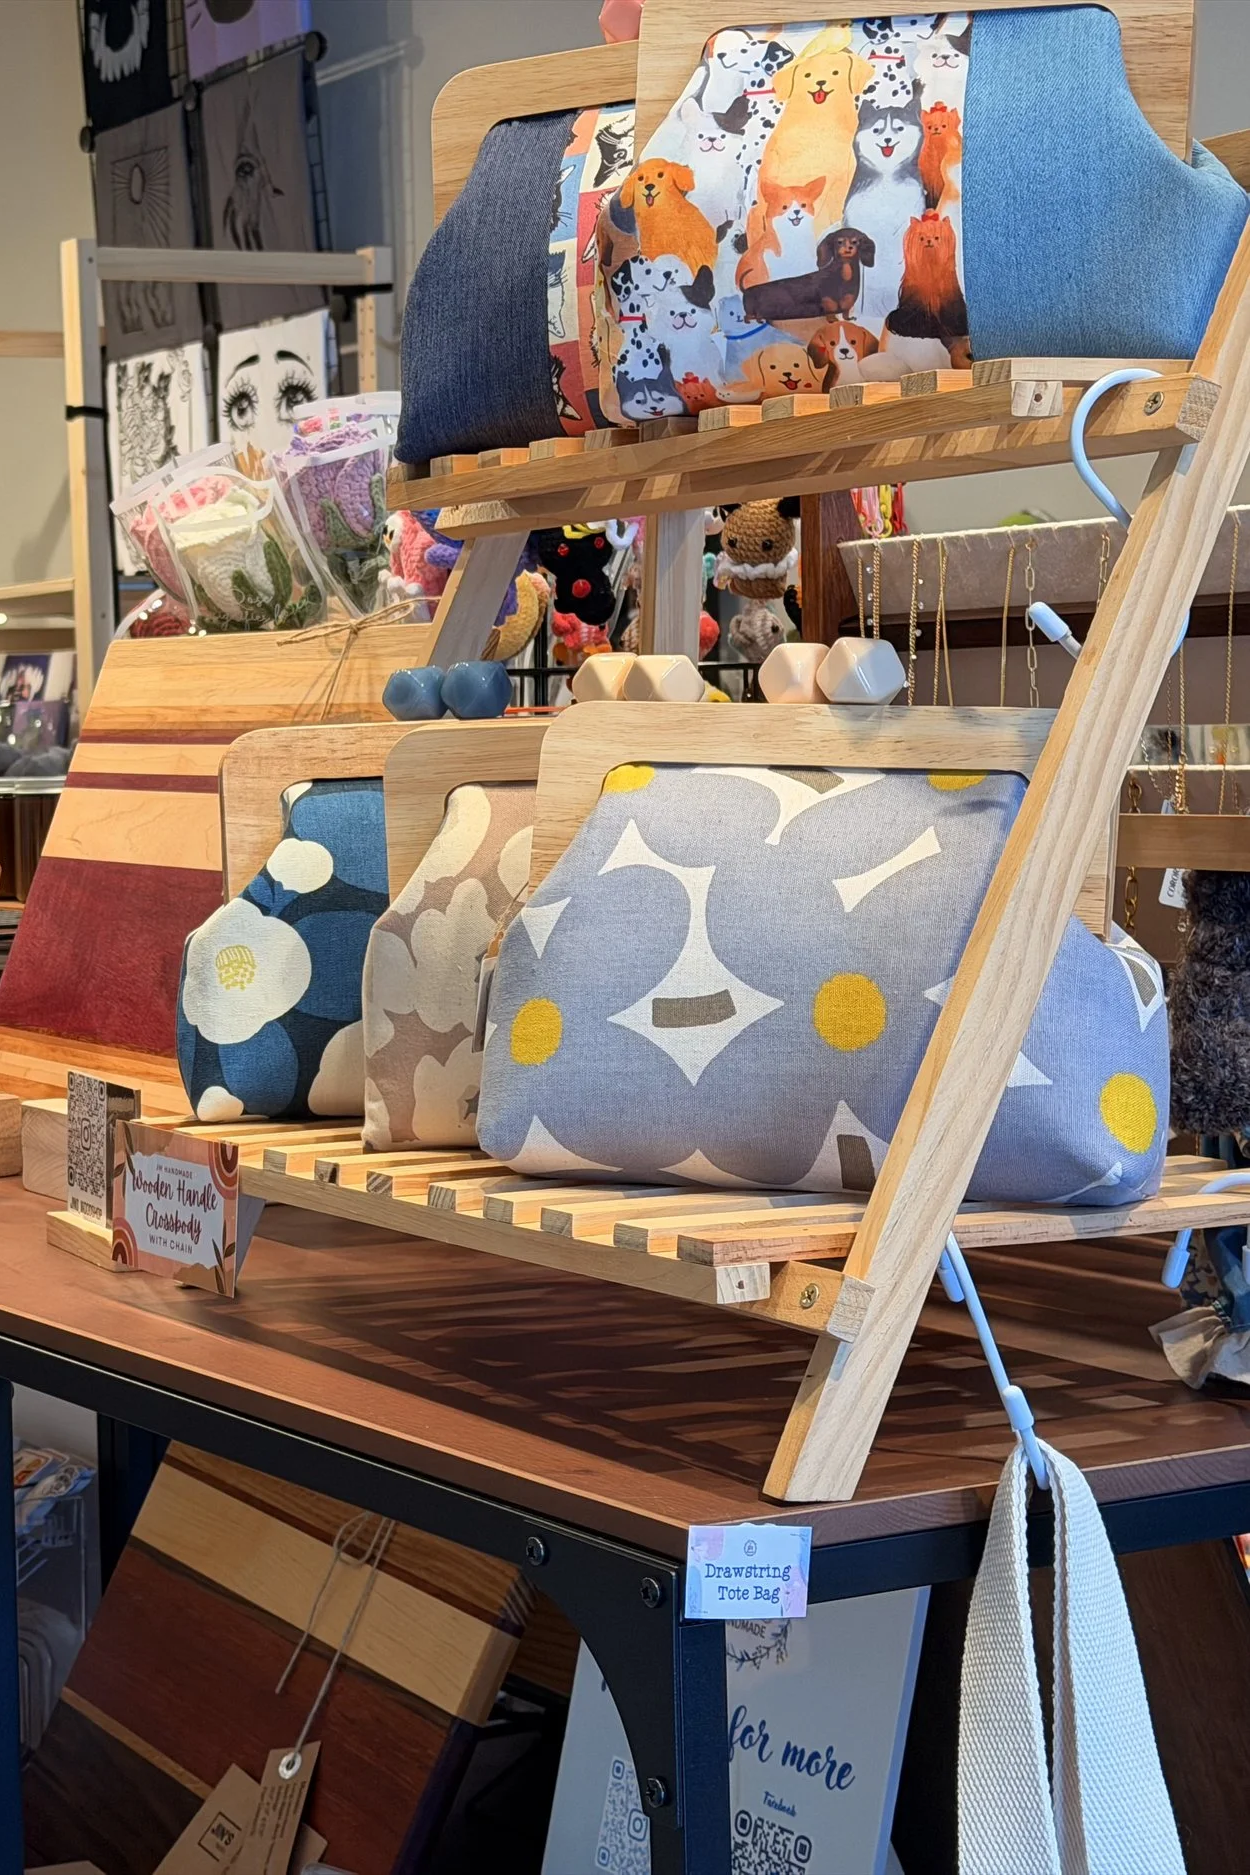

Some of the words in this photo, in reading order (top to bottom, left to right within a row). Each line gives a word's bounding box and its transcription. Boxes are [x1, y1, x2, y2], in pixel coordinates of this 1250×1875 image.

[164, 1166, 193, 1180] HANDMADE
[132, 1169, 174, 1201] Wooden
[177, 1179, 219, 1213] Handle
[146, 1202, 202, 1245] Crossbody
[149, 1233, 168, 1247] WITH
[170, 1239, 193, 1255] CHAIN
[704, 1562, 792, 1582] Drawstring
[718, 1585, 750, 1601] Tote
[753, 1585, 781, 1604] Bag
[728, 1704, 773, 1763] for
[780, 1739, 856, 1791] more
